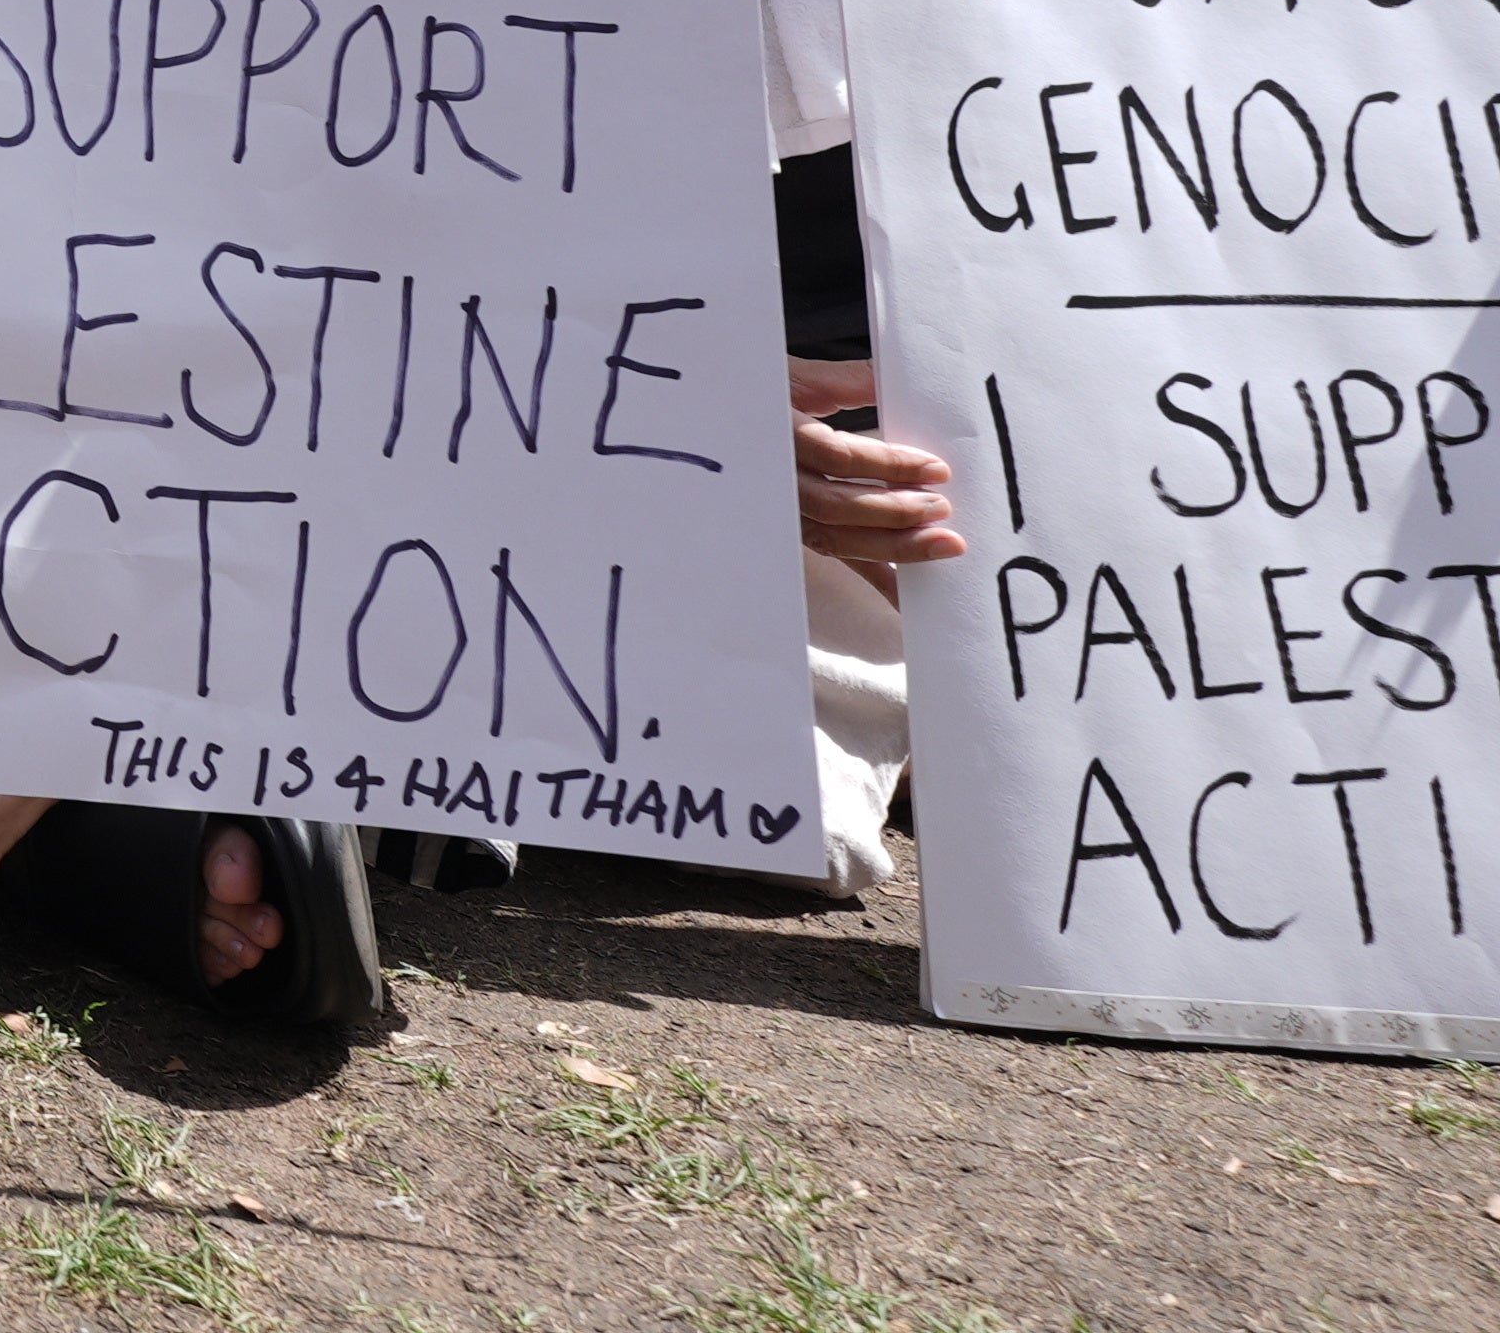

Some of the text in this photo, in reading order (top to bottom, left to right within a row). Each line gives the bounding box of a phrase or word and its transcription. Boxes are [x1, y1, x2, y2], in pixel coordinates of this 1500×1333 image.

[985, 372, 1026, 534] I
[90, 717, 730, 842] THIS IS 4 HAITHAM
